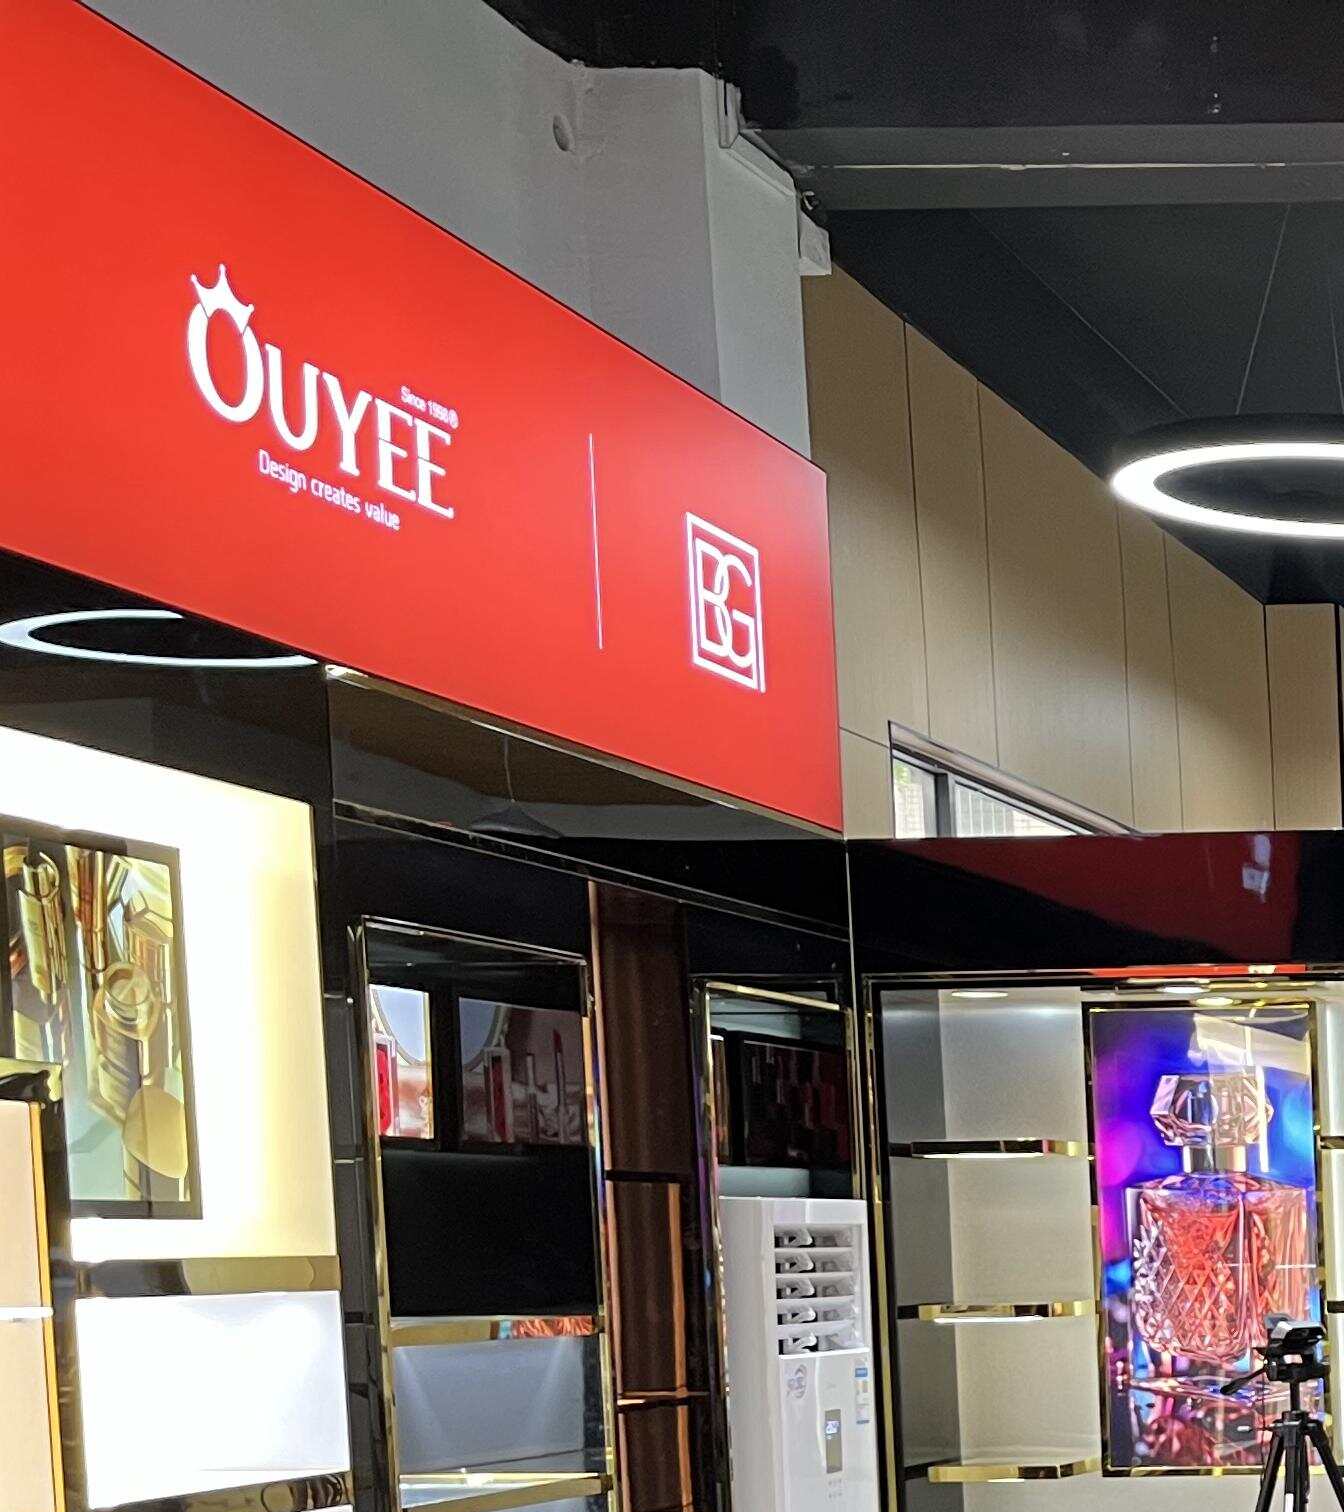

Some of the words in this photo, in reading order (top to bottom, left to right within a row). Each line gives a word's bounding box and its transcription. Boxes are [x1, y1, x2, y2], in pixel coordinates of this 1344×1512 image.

[187, 264, 454, 519] OUYEE
[258, 449, 307, 493] Design
[310, 478, 361, 514] creates
[365, 501, 401, 531] value
